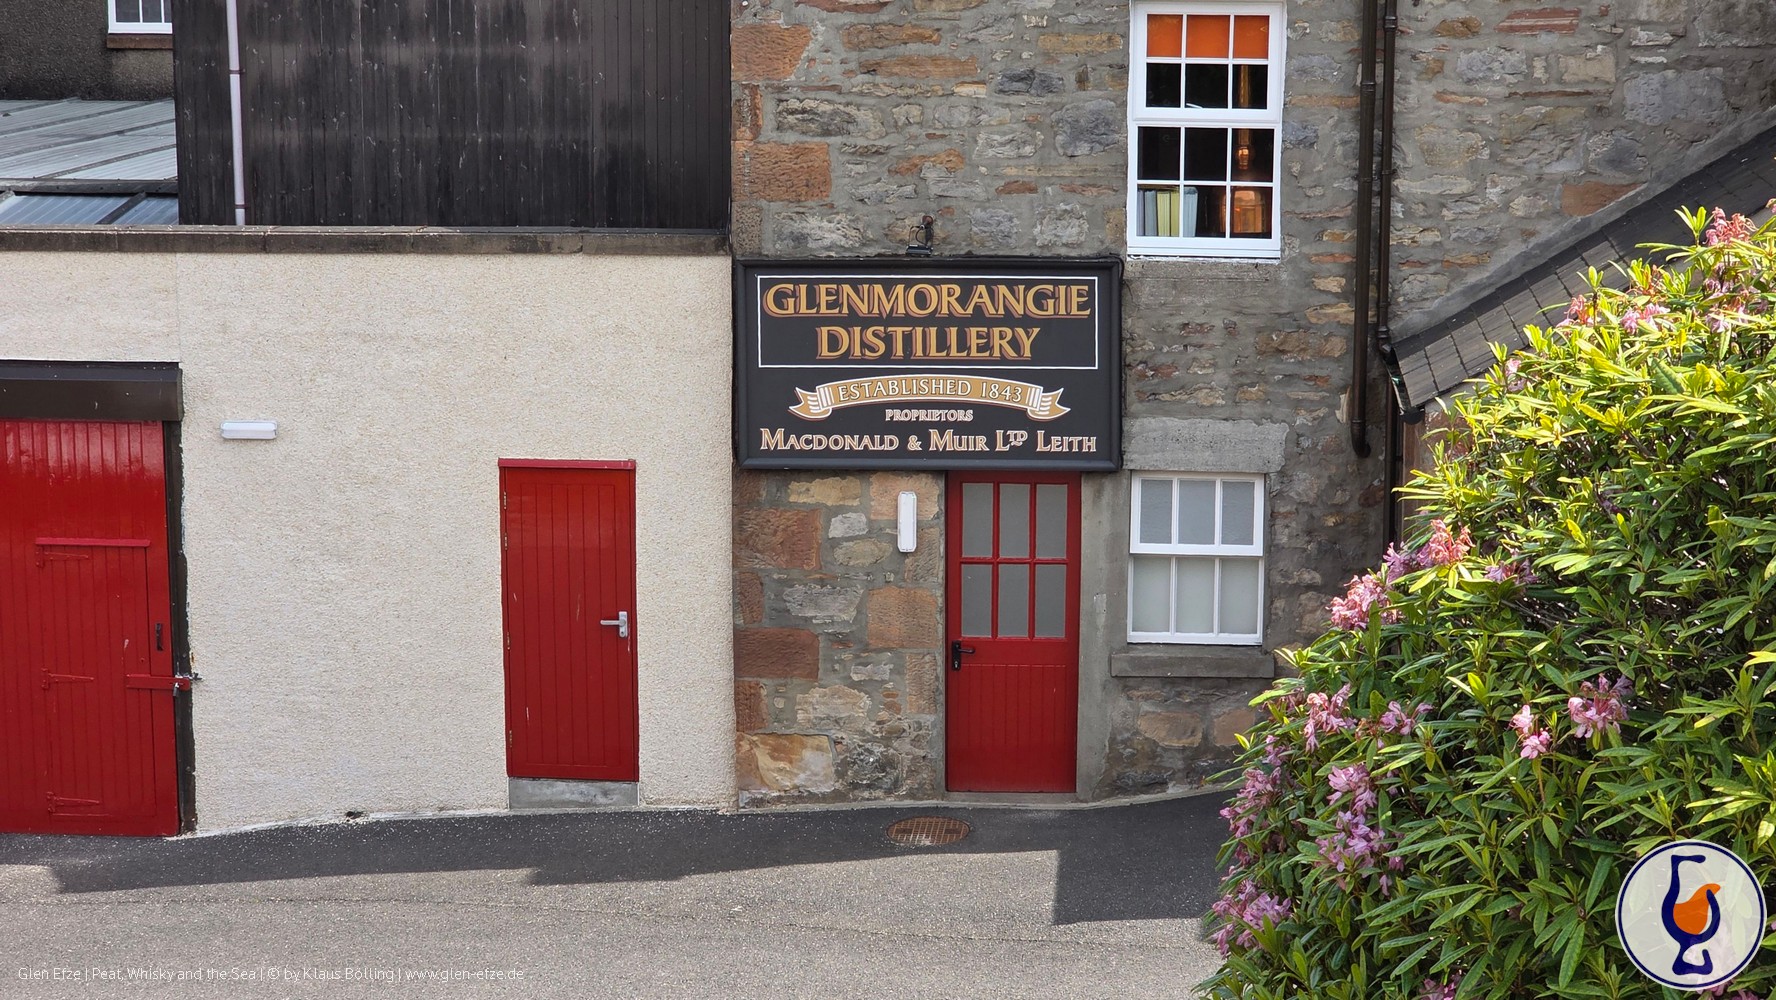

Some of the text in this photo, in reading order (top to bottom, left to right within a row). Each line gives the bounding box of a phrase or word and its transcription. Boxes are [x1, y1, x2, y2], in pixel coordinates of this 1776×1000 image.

[763, 283, 1091, 319] GLENMORANGIE
[815, 326, 1041, 360] DISTILLERY
[837, 378, 1023, 403] ESTABLISHED 1843
[885, 408, 974, 422] PROPRIETORS
[907, 434, 922, 451] &
